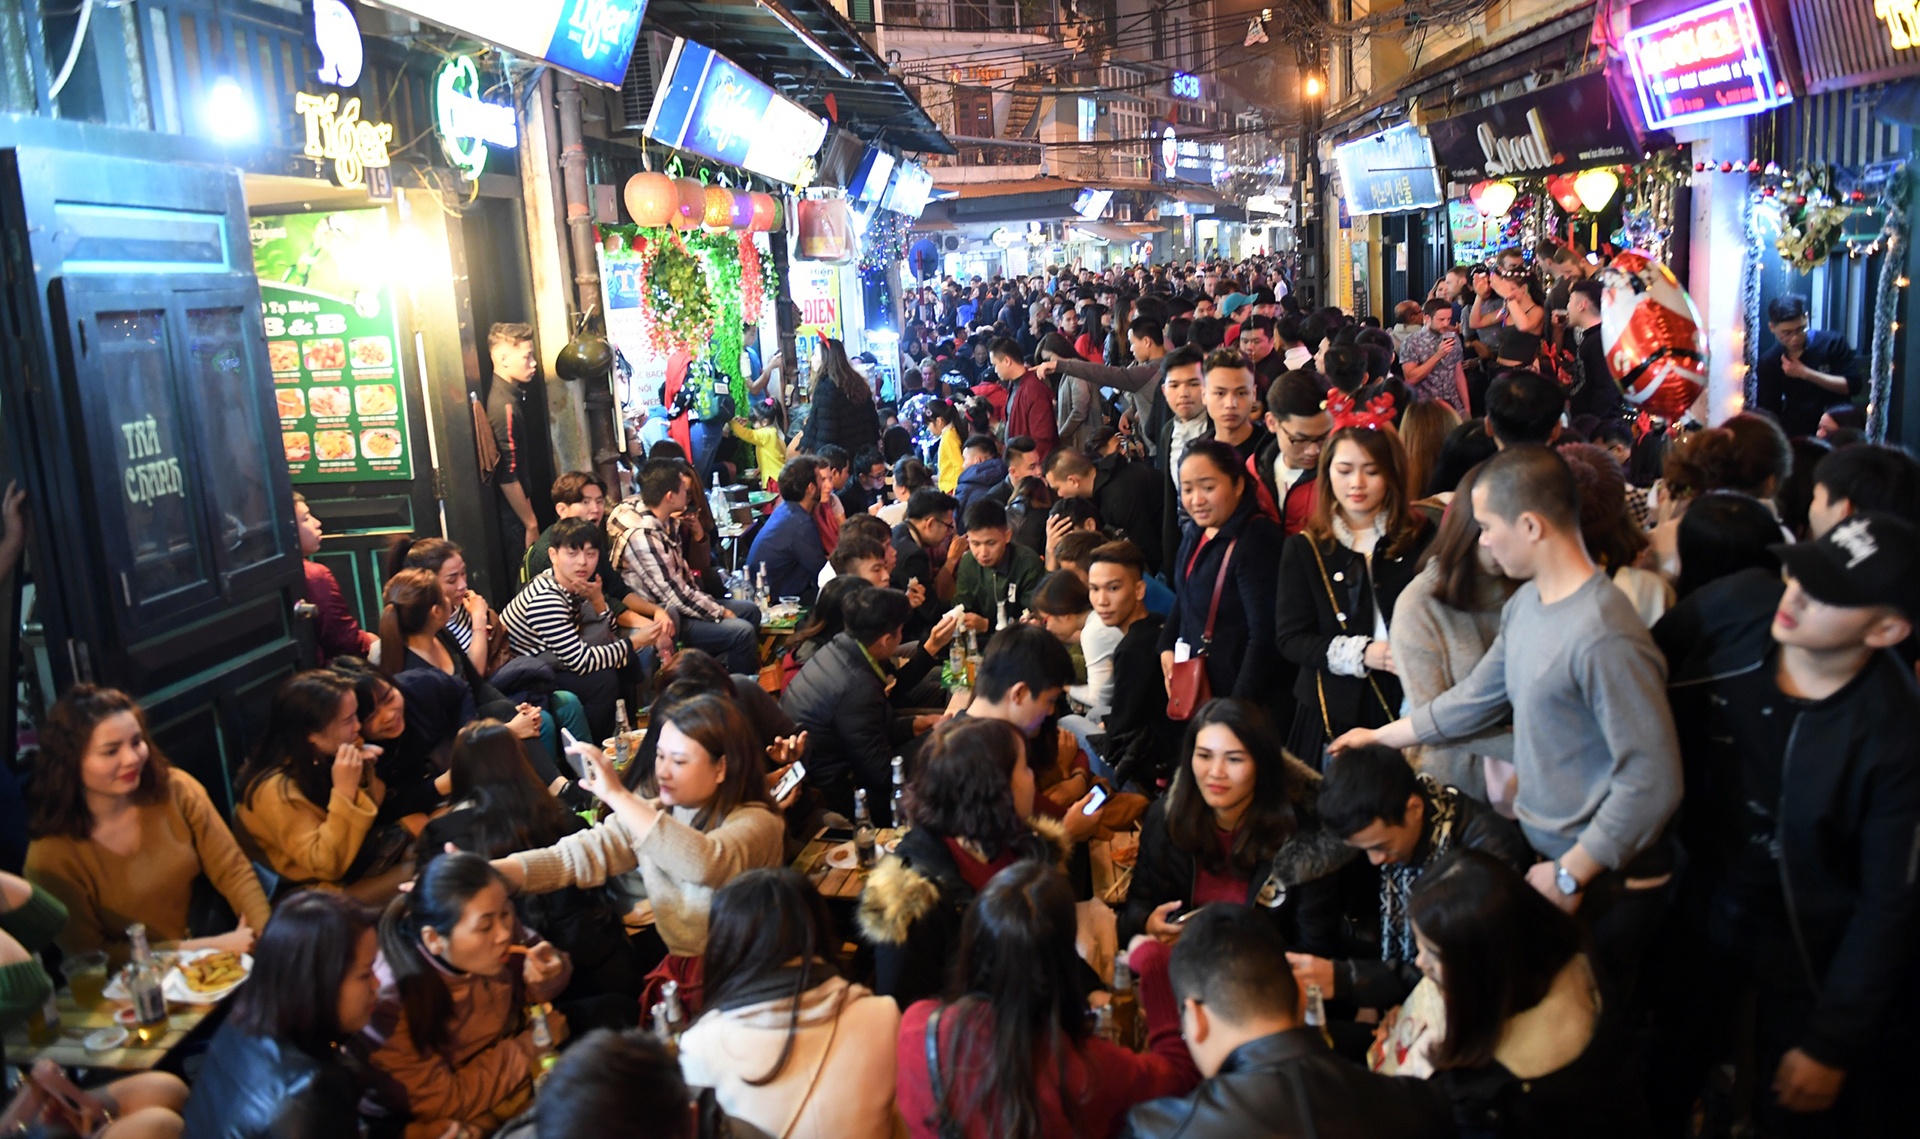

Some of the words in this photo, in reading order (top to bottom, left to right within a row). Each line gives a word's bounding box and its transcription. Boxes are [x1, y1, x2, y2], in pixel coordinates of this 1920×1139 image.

[1173, 72, 1200, 98] SCB
[296, 91, 393, 190] Tiger
[369, 167, 389, 196] 19
[314, 313, 348, 335] B
[121, 413, 162, 460] TRÀ
